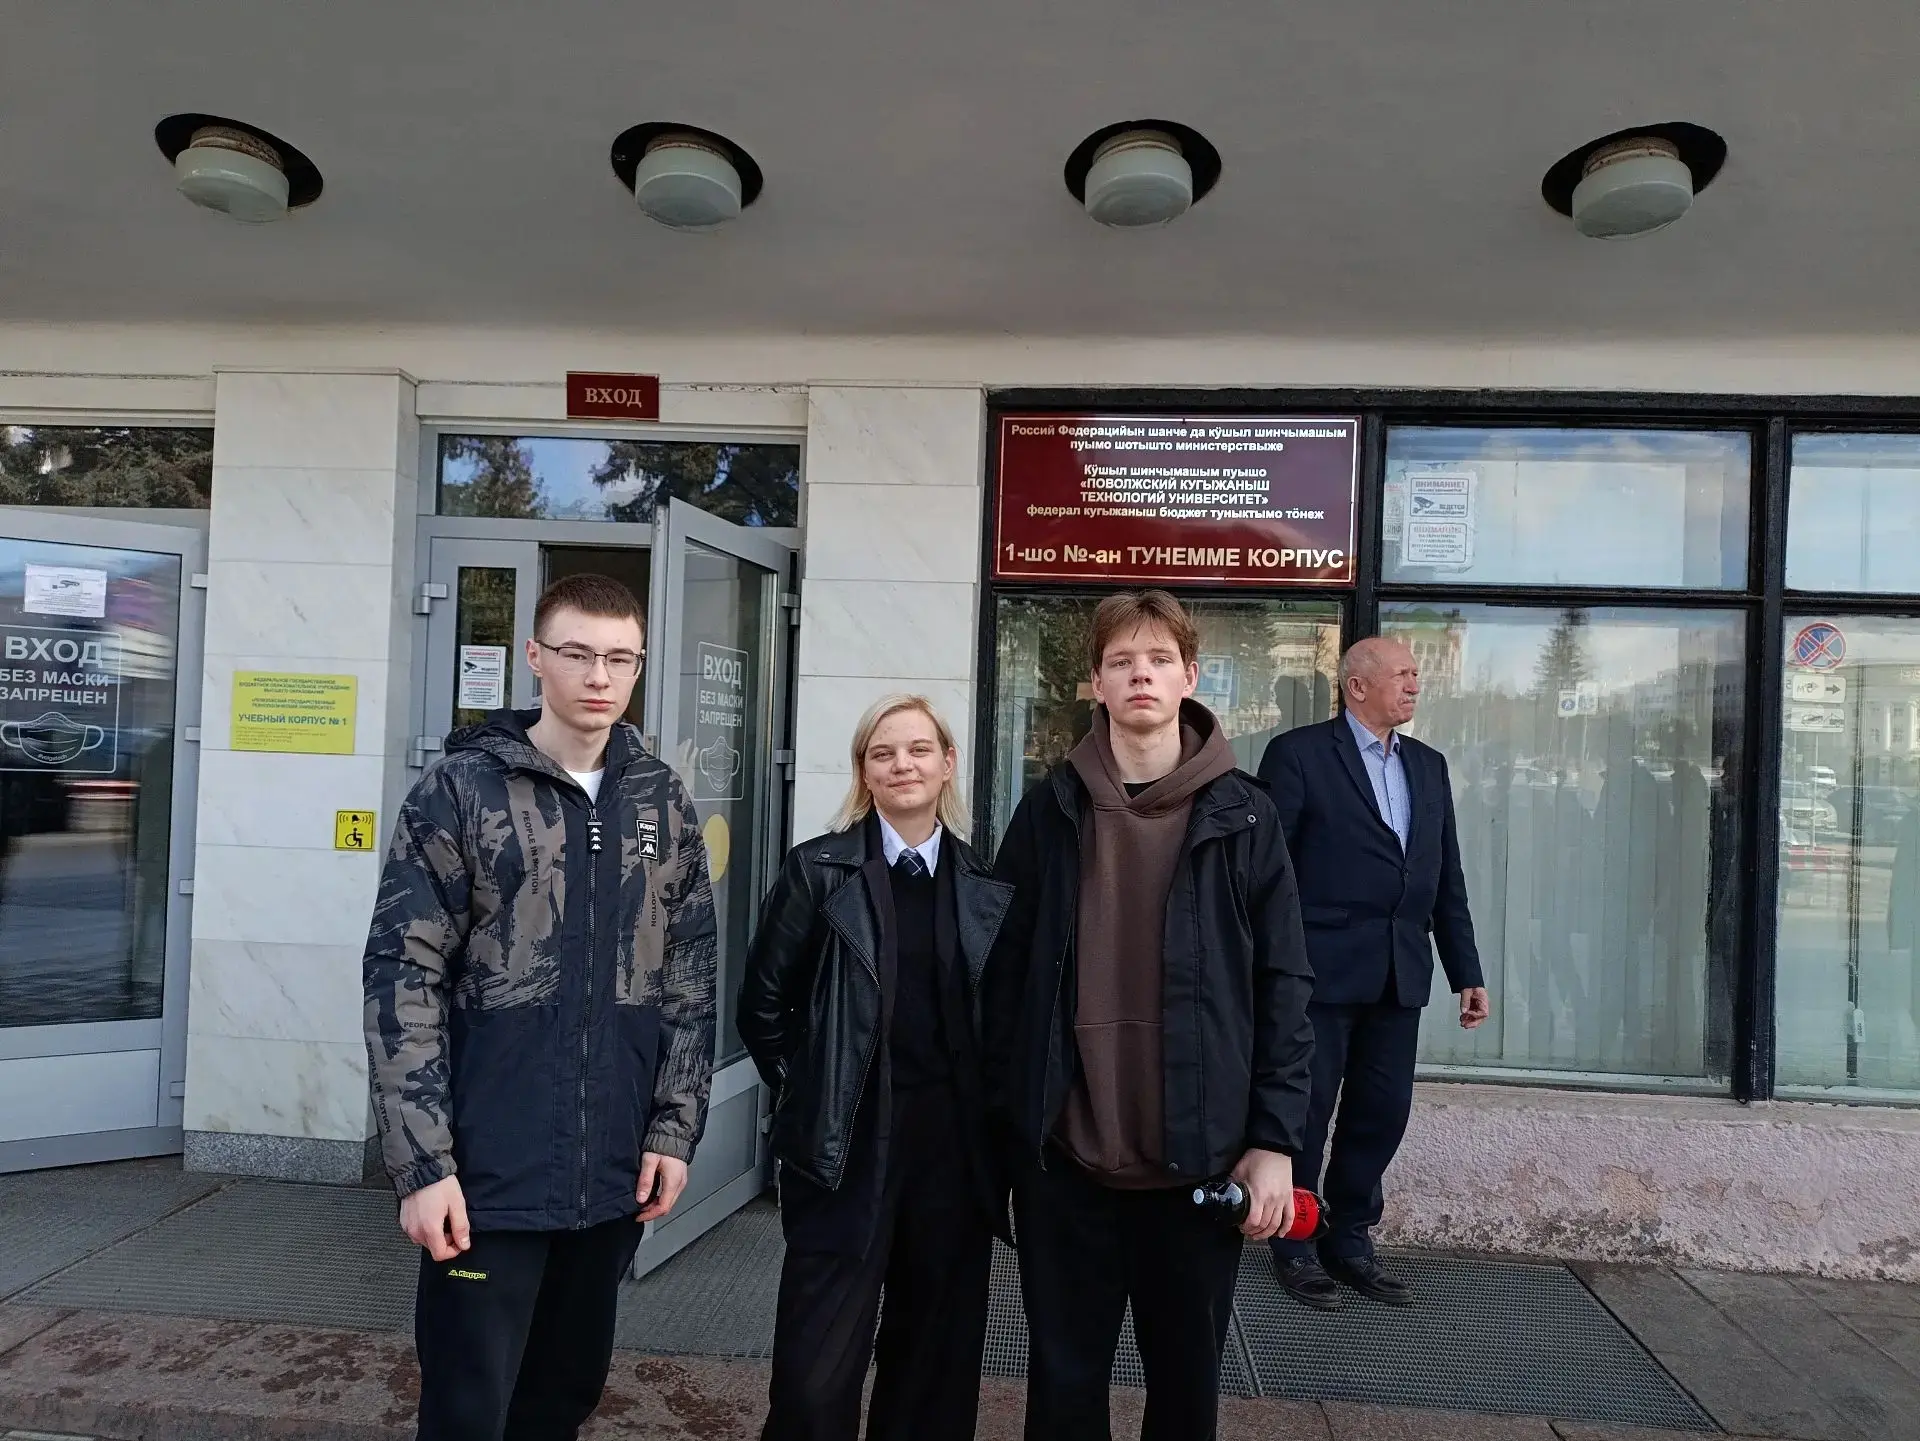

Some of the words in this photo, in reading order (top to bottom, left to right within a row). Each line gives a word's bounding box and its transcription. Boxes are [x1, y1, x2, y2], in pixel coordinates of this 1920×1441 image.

[584, 387, 642, 408] ВХОД
[1011, 425, 1055, 436] Россий
[1058, 425, 1145, 438] Федерацийын
[1149, 427, 1187, 437] шанче
[1190, 428, 1205, 438] да
[1255, 428, 1347, 438] шинчымашым
[1070, 440, 1112, 451] пуымо
[1114, 441, 1173, 450] шотышто
[1176, 442, 1284, 452] министерствыже
[1130, 467, 1219, 477] шинчымашым
[1222, 468, 1267, 479] пуышо
[1080, 477, 1177, 490] «ПОВОЛЖСКИЙ
[1180, 479, 1270, 491] КУГЫЖАНЫШ
[1080, 491, 1165, 503] ТЕХНОЛОГИЙ
[1168, 493, 1269, 505] УНИВЕРСИТЕТ»
[1026, 504, 1081, 516] федерал
[1083, 506, 1157, 518] кугыжаныш
[1159, 506, 1207, 519] бюджет
[1210, 508, 1283, 520] туныктымо
[1005, 543, 1057, 561] 1-шо
[1063, 544, 1121, 564] №-ан
[1127, 546, 1241, 567] ТУНЕММЕ
[1247, 548, 1344, 568] КОРПУС
[5, 636, 103, 668] ВХОД
[0, 669, 36, 682] БЕЗ
[42, 670, 109, 687] МАСКИ
[703, 654, 742, 690] ВХОД
[0, 686, 107, 706] ЗАПРЕЩЕН
[700, 690, 716, 705] БЕЗ
[717, 692, 743, 709] МАСКИ
[238, 713, 286, 723] УЧЕБНЫЙ
[288, 716, 326, 725] КОРПУС
[699, 709, 742, 728] ЗАПРЕЩЕН
[522, 810, 536, 845] PEOPLE
[530, 845, 538, 857] IN
[531, 857, 539, 895] MOTION
[366, 1041, 379, 1081] PEOPLE
[374, 1081, 384, 1093] IN
[378, 1094, 392, 1134] MOTION
[458, 1270, 487, 1280] Kappa
